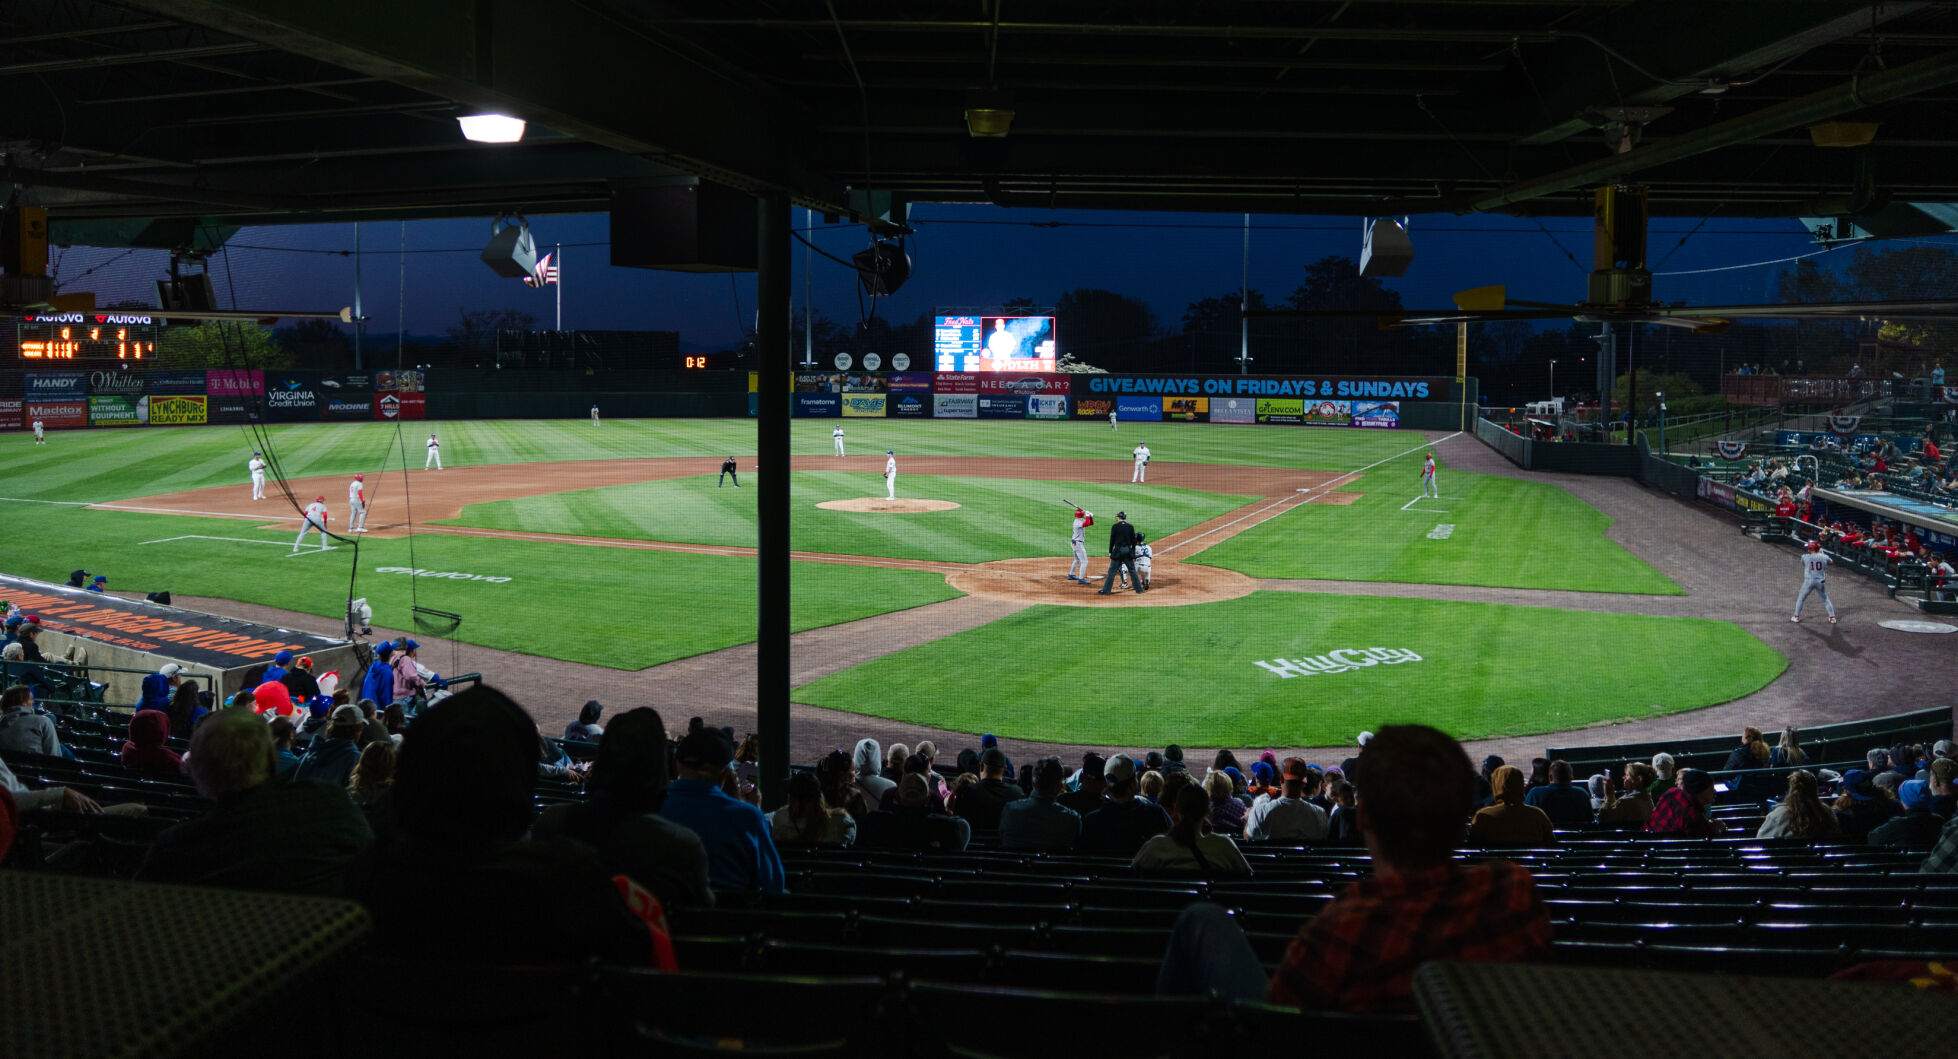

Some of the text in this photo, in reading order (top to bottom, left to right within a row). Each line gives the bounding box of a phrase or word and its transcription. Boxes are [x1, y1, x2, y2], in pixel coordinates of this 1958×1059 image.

[107, 314, 151, 325] Autova
[685, 357, 706, 368] 0:12
[33, 378, 78, 388] HANDY
[91, 371, 145, 388] Whitten
[1036, 381, 1070, 389] CAR?
[1089, 378, 1430, 398] GIVEAWAYS ON FRIDAYS & SUNDAYS
[269, 391, 315, 400] VIRGINIA
[30, 406, 82, 416] Maddox
[91, 404, 126, 412] WITHOUT
[152, 399, 205, 415] LYNCHBURG
[91, 412, 136, 420] EQUIPMENT
[151, 415, 184, 423] READY
[1810, 561, 1823, 571] 10
